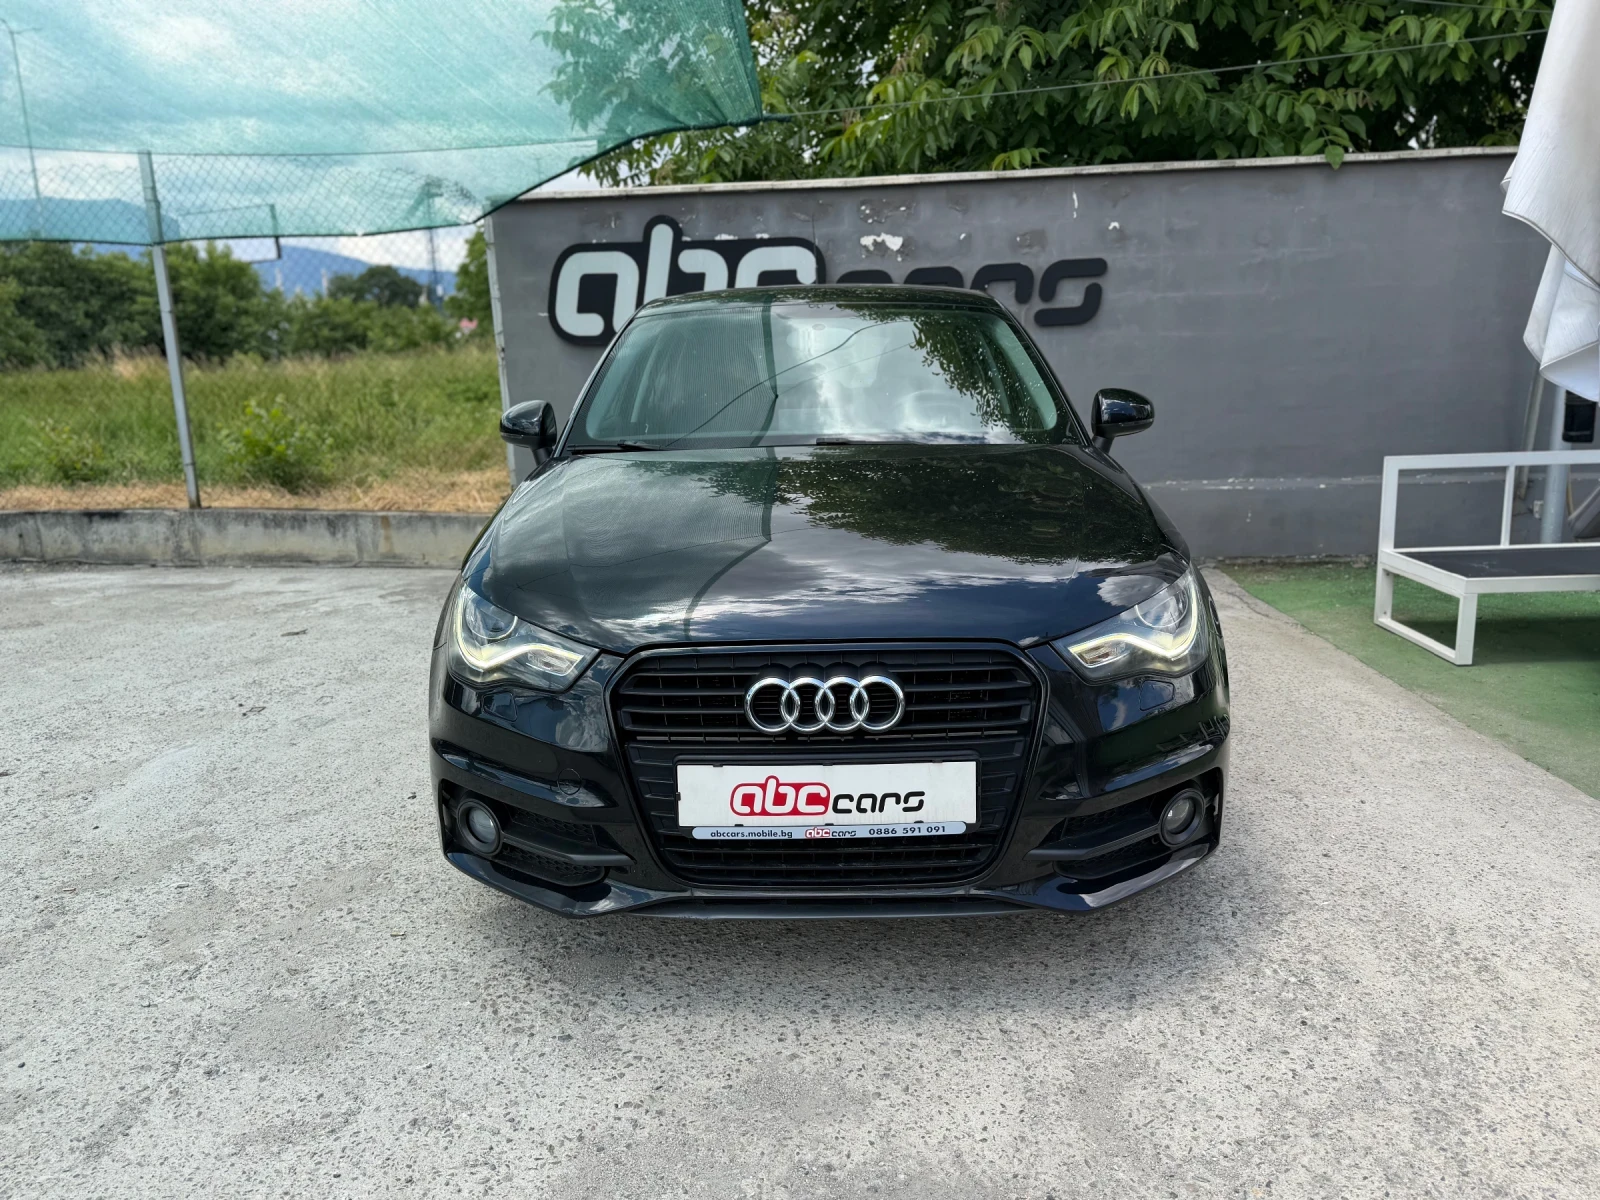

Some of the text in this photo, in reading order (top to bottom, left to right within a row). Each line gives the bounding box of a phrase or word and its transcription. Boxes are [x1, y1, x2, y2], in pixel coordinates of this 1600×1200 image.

[731, 775, 925, 815] abc cars
[710, 829, 793, 839] abccars.mobile.bg
[805, 827, 830, 838] abc
[868, 828, 897, 836] 0886
[902, 826, 922, 834] 591
[926, 825, 946, 833] 091
